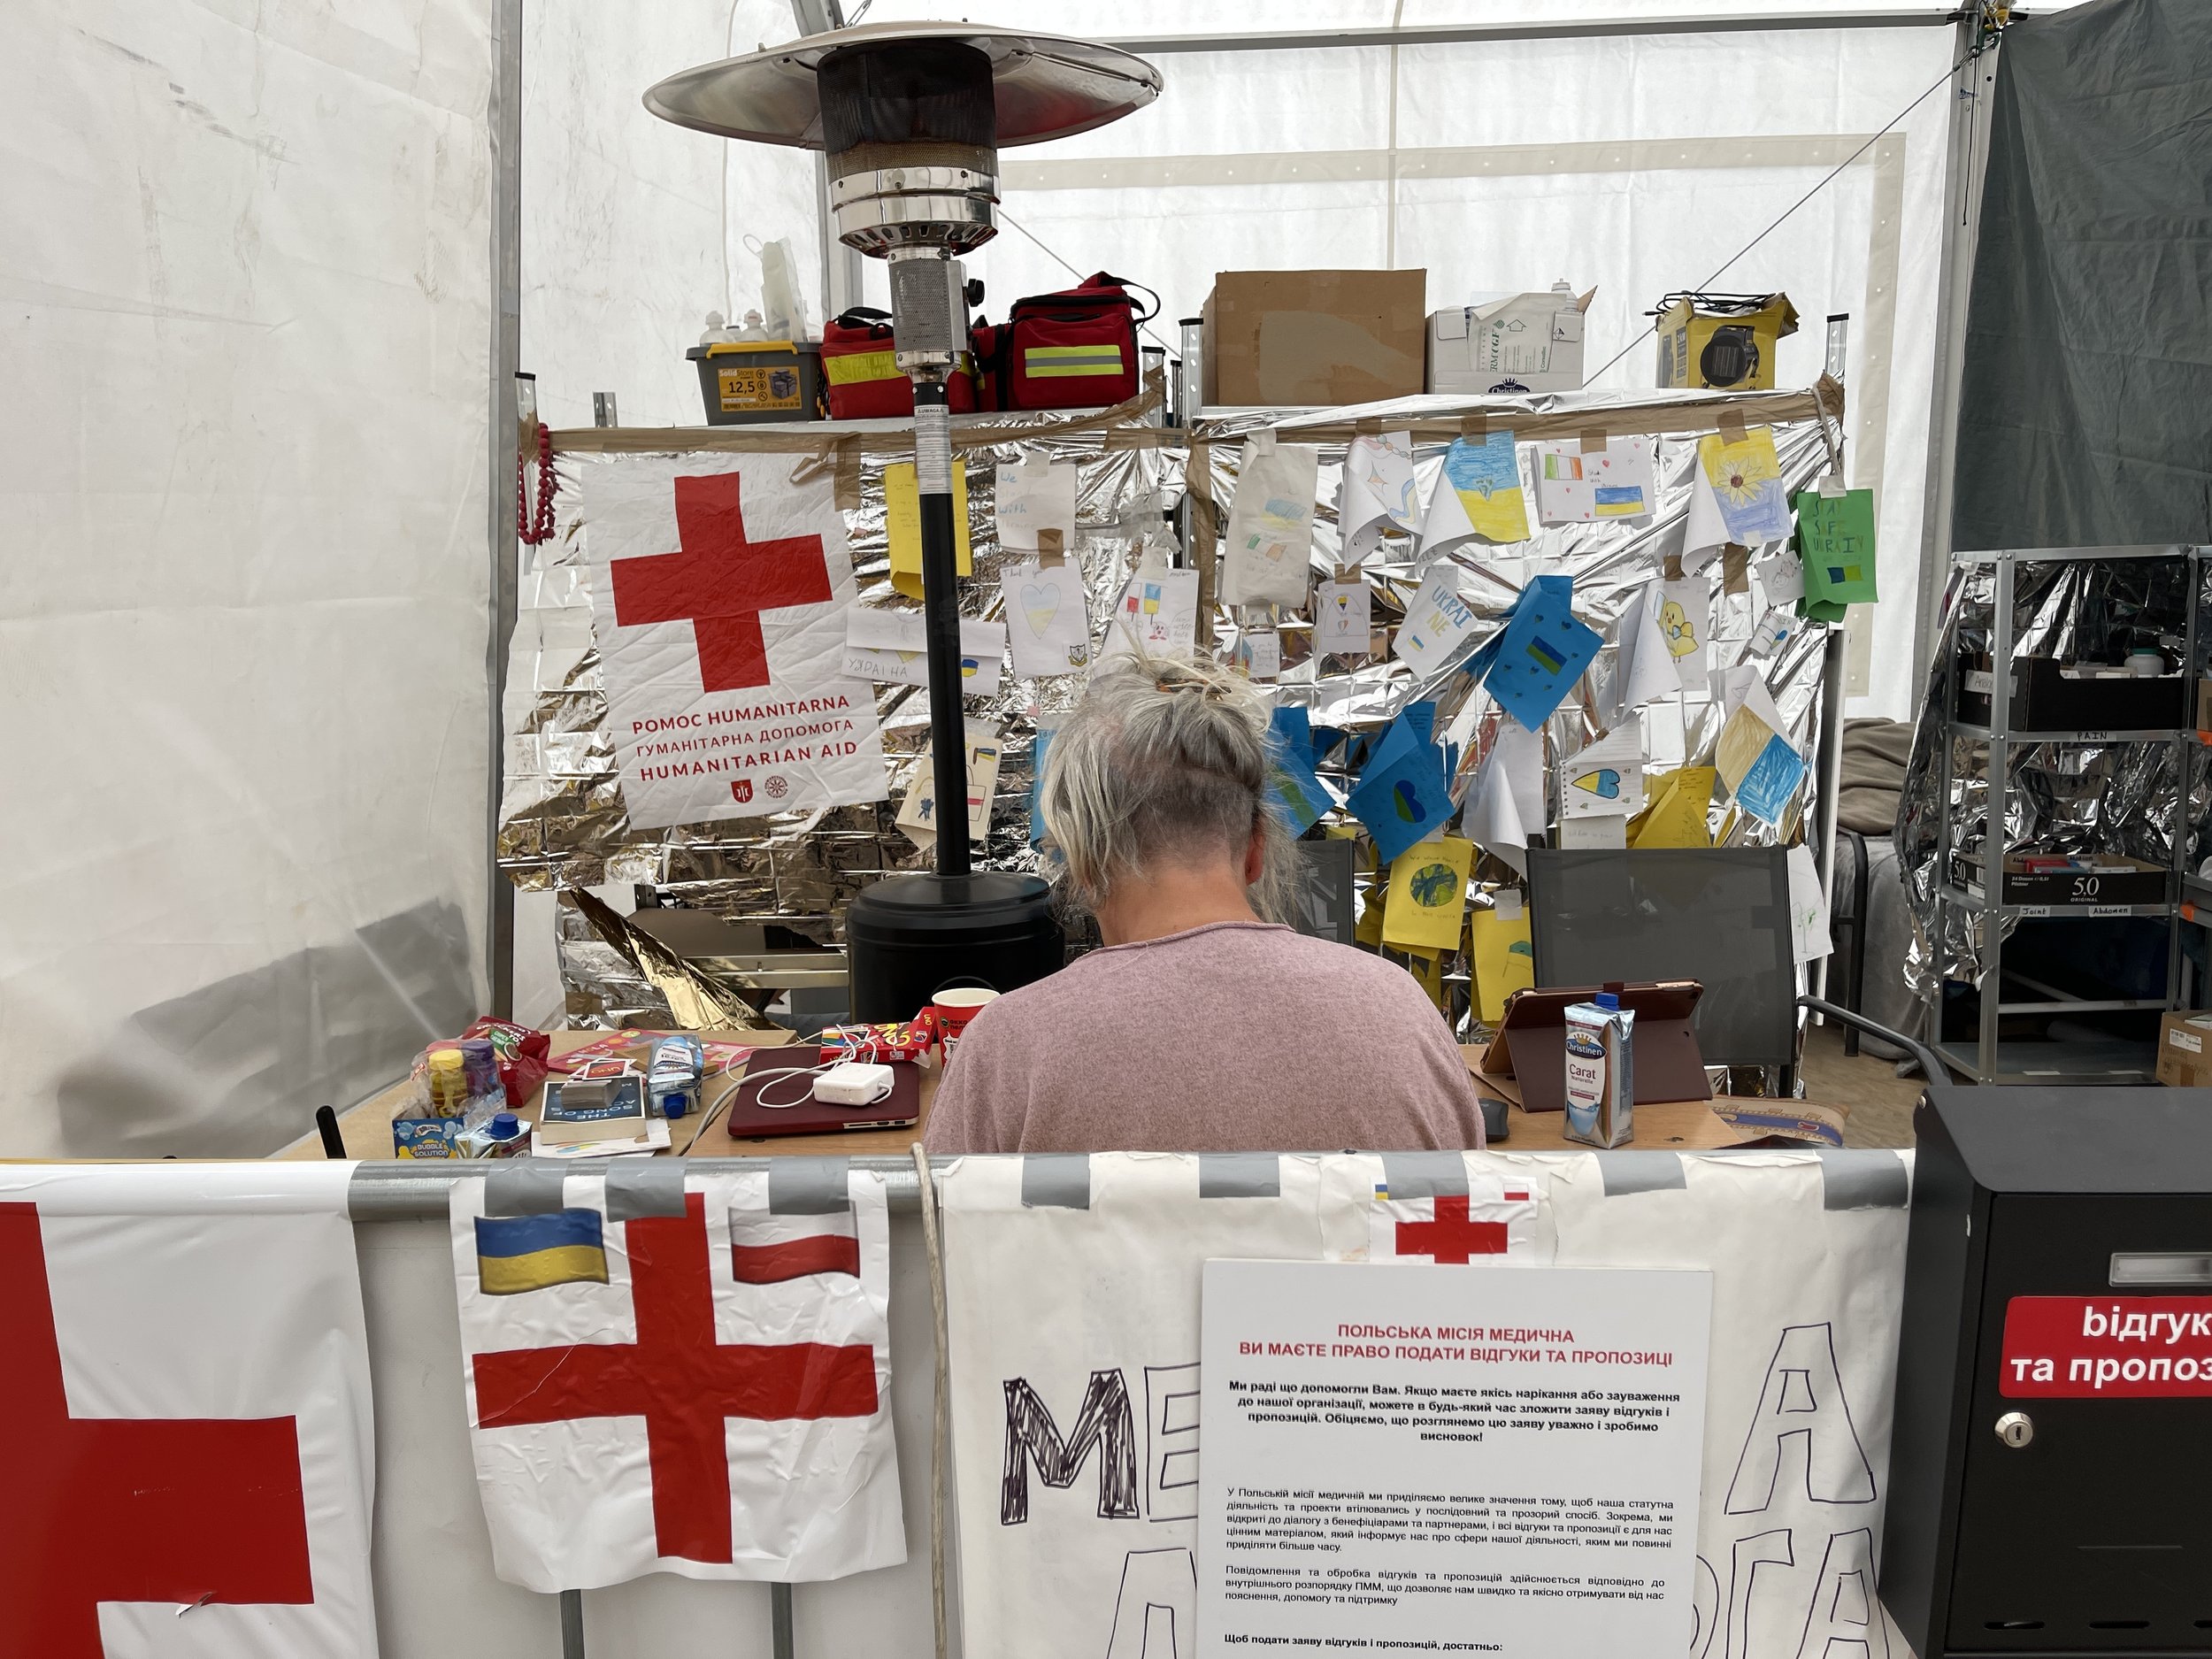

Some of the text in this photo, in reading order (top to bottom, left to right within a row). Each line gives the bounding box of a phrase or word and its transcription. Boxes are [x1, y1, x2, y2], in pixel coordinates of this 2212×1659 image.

[718, 368, 754, 378] SolidStore
[728, 380, 756, 395] 12,5
[1432, 585, 1473, 629] UKRAI
[1425, 610, 1450, 638] NE
[632, 695, 849, 734] POMOC HUMANITARNA
[637, 718, 853, 757] ГУМАНІТАРНА ДОПОМОГА
[2077, 731, 2108, 741] PAIN
[640, 741, 857, 781] HUMANITARIAN AID
[2072, 877, 2100, 897] 5,0
[2093, 906, 2128, 915] Abdomen
[1566, 1041, 1602, 1056] Christinen
[1570, 1064, 1596, 1079] Carat
[583, 1104, 634, 1115] SONG
[1338, 1324, 1574, 1341] ПОЛЬСЬКА МІСІЯ МЕДИЧНА
[1240, 1341, 1671, 1366] ВИ МАЄТЕ ПРАВО ПОДАТИ ВІДГУКИ ТА ПРОПОЗИЦІ
[2010, 1357, 2212, 1390] та пропоз
[1229, 1380, 1246, 1391] Ми
[1250, 1380, 1276, 1394] раді
[1279, 1384, 1297, 1394] що
[1301, 1384, 1368, 1395] допомогли
[1372, 1384, 1400, 1394] Вам.
[1404, 1385, 1437, 1397] Якщо
[1480, 1386, 1512, 1397] якісь
[1516, 1387, 1577, 1401] нарікання
[1580, 1389, 1603, 1400] або
[1607, 1393, 1679, 1403] зауваження
[1237, 1397, 1253, 1407] до
[1257, 1396, 1294, 1407] нашої
[1296, 1397, 1364, 1410] організації,
[1370, 1401, 1414, 1409] можете
[1428, 1401, 1491, 1414] будь-який
[1519, 1405, 1571, 1414] зложити
[1575, 1407, 1609, 1417] заяву
[1614, 1406, 1662, 1418] відгуків
[1666, 1407, 1669, 1416] і
[1248, 1410, 1658, 1432] пропозицій. Обіцяємо, що розглянемо цю заяву уважно і зробимо
[1420, 1431, 1482, 1441] висновок!
[1227, 1487, 1234, 1496] У
[1239, 1487, 1288, 1498] Польській
[1293, 1489, 1314, 1498] місії
[1318, 1490, 1363, 1501] медичній
[1386, 1492, 1445, 1503] приділяємо
[1540, 1498, 1566, 1508] тому,
[1571, 1497, 1593, 1508] щоб
[1629, 1501, 1673, 1510] статутна
[1226, 1500, 1278, 1511] діяльність
[1301, 1504, 1340, 1514] проекти
[1347, 1504, 1409, 1514] втілювались
[1415, 1508, 1421, 1517] у
[1426, 1506, 1489, 1517] послідовний
[1512, 1509, 1559, 1520] прозорий
[1565, 1510, 1600, 1519] спосіб.
[1606, 1511, 1652, 1523] Зокрема,
[1226, 1526, 1260, 1537] цінним
[1265, 1527, 1325, 1540] матеріалом,
[1357, 1530, 1406, 1541] інформує
[1432, 1534, 1450, 1543] про
[1455, 1532, 1486, 1544] сфери
[1492, 1534, 1522, 1543] нашої
[1525, 1535, 1580, 1547] діяльності,
[1632, 1538, 1671, 1548] повинні
[1226, 1540, 1341, 1553] приділяти більше часу.
[1226, 1565, 1300, 1577] Повідомлення
[1327, 1568, 1370, 1579] обробка
[1379, 1570, 1417, 1581] відгуків
[1444, 1571, 1502, 1583] пропозицій
[1509, 1573, 1579, 1585] здійснюється
[1587, 1576, 1644, 1587] відповідно
[1225, 1578, 1292, 1590] внутрішнього
[1295, 1582, 1352, 1592] розпорядку
[1356, 1582, 1384, 1592] ПММ,
[1404, 1585, 1451, 1594] дозволяє
[1478, 1587, 1515, 1596] швидко
[1532, 1587, 1563, 1596] якісно
[1566, 1590, 1624, 1600] отримувати
[1628, 1590, 1642, 1600] від
[1225, 1593, 1280, 1601] пояснення,
[1283, 1594, 1331, 1604] допомогу
[1348, 1594, 1397, 1606] підтримку
[1225, 1633, 1502, 1652] Щоб подати заяву відгуків і пропозицій, достатньо:
